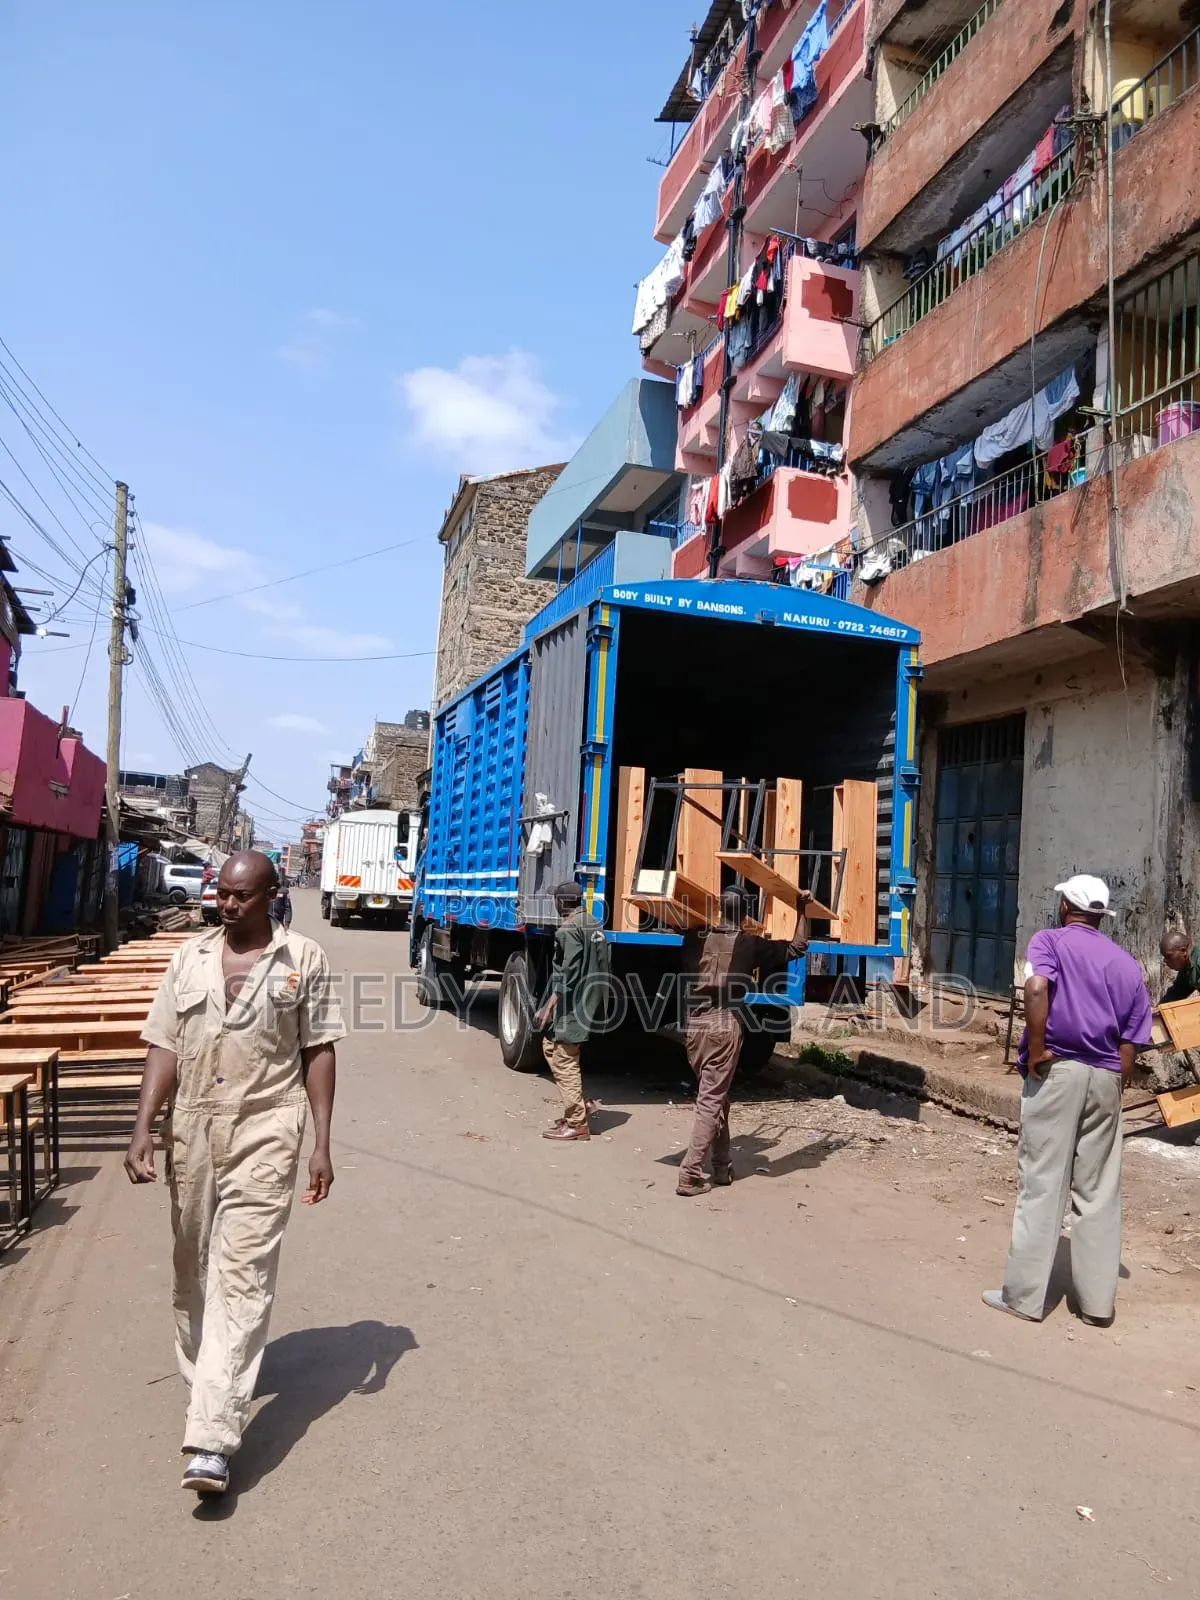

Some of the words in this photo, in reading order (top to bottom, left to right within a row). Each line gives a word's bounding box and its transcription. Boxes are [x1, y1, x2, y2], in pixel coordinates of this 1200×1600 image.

[613, 588, 638, 600] BODY
[644, 593, 673, 606] BUILT
[678, 598, 692, 608] BY
[783, 612, 830, 627] NAKURU
